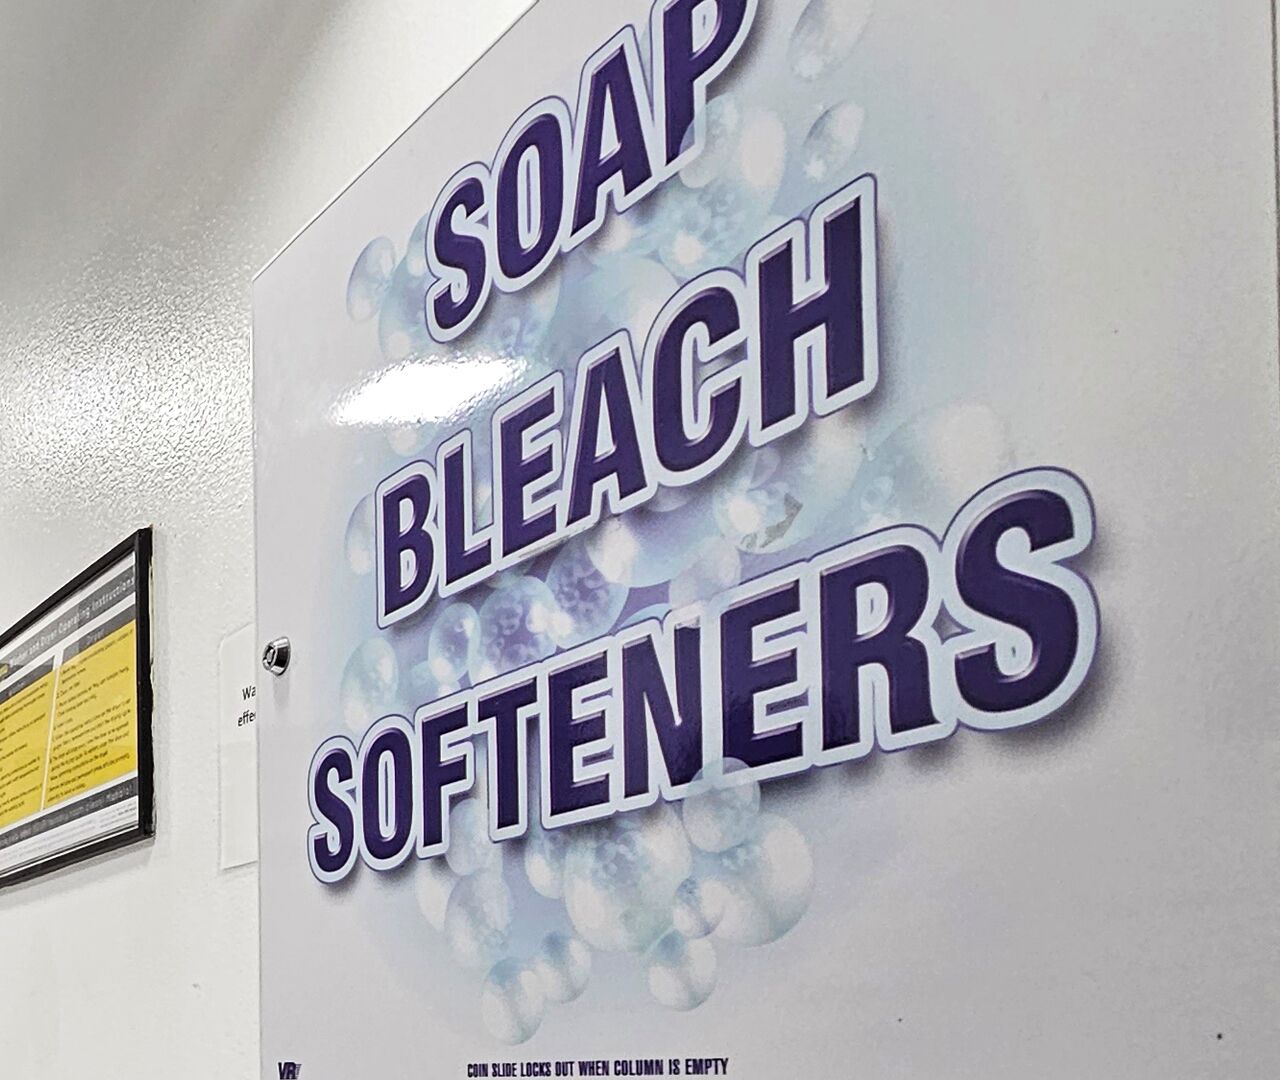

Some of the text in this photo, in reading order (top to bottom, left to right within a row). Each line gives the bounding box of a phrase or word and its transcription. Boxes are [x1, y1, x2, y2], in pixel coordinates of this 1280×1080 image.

[428, 0, 758, 340] SOAP
[376, 172, 877, 629] BLEACH
[237, 709, 256, 727] effe
[307, 466, 1097, 883] SOFTENERS
[467, 1058, 728, 1078] COIN SLIDE LOCKS OUT WHEN COLUMN IS EMPTY
